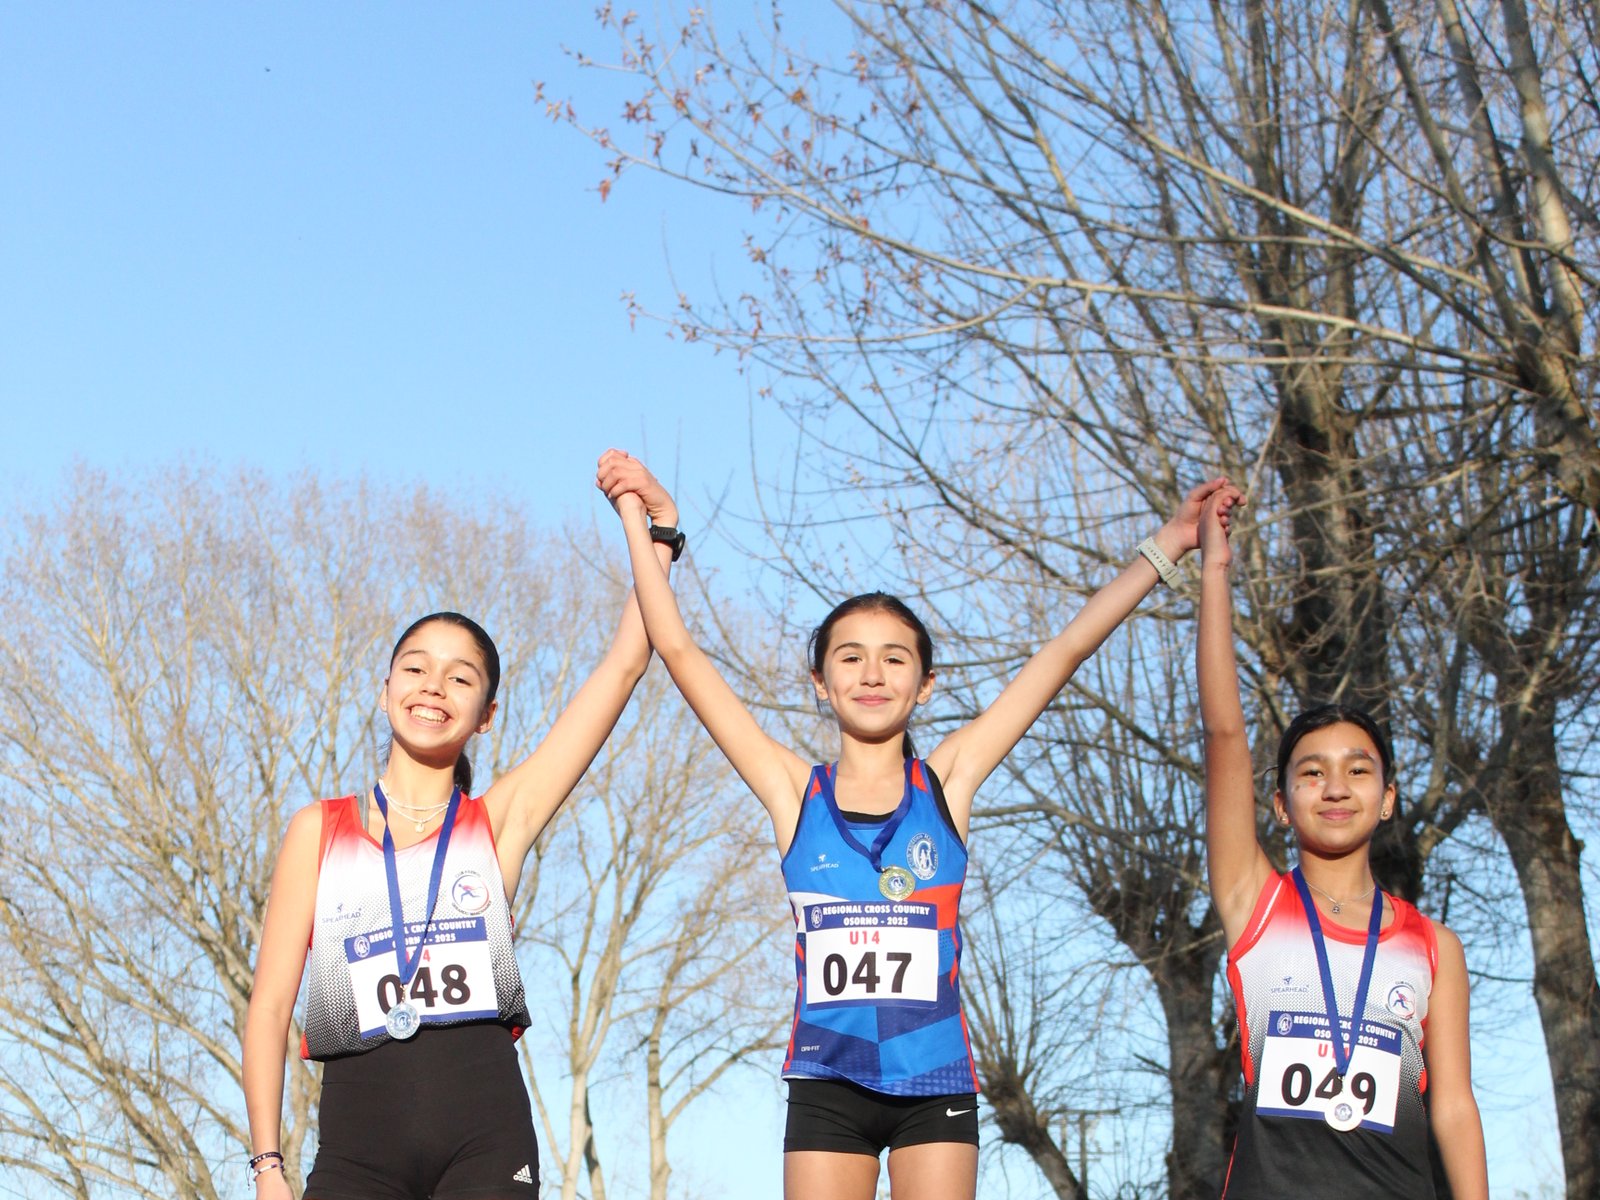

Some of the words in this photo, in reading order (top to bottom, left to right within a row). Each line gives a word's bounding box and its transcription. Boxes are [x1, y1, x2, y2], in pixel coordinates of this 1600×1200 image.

[822, 905, 862, 915] REGIONAL
[864, 904, 890, 914] CROSS
[893, 905, 930, 915] COUNTRY
[843, 917, 878, 926] OSORNO
[887, 917, 908, 926] 2025
[369, 926, 409, 943] REGIOL
[438, 920, 477, 931] COUNTRY
[434, 933, 456, 943] 2025
[850, 931, 880, 945] U14
[823, 951, 912, 996] 047
[377, 964, 471, 1016] 048
[1271, 986, 1308, 994] SPEARHEAD
[1293, 1015, 1330, 1027] REGIONA
[1365, 1024, 1397, 1040] COUNTRY
[1314, 1029, 1350, 1041] OSOO
[1358, 1035, 1378, 1047] 2025
[1281, 1063, 1376, 1116] 049
